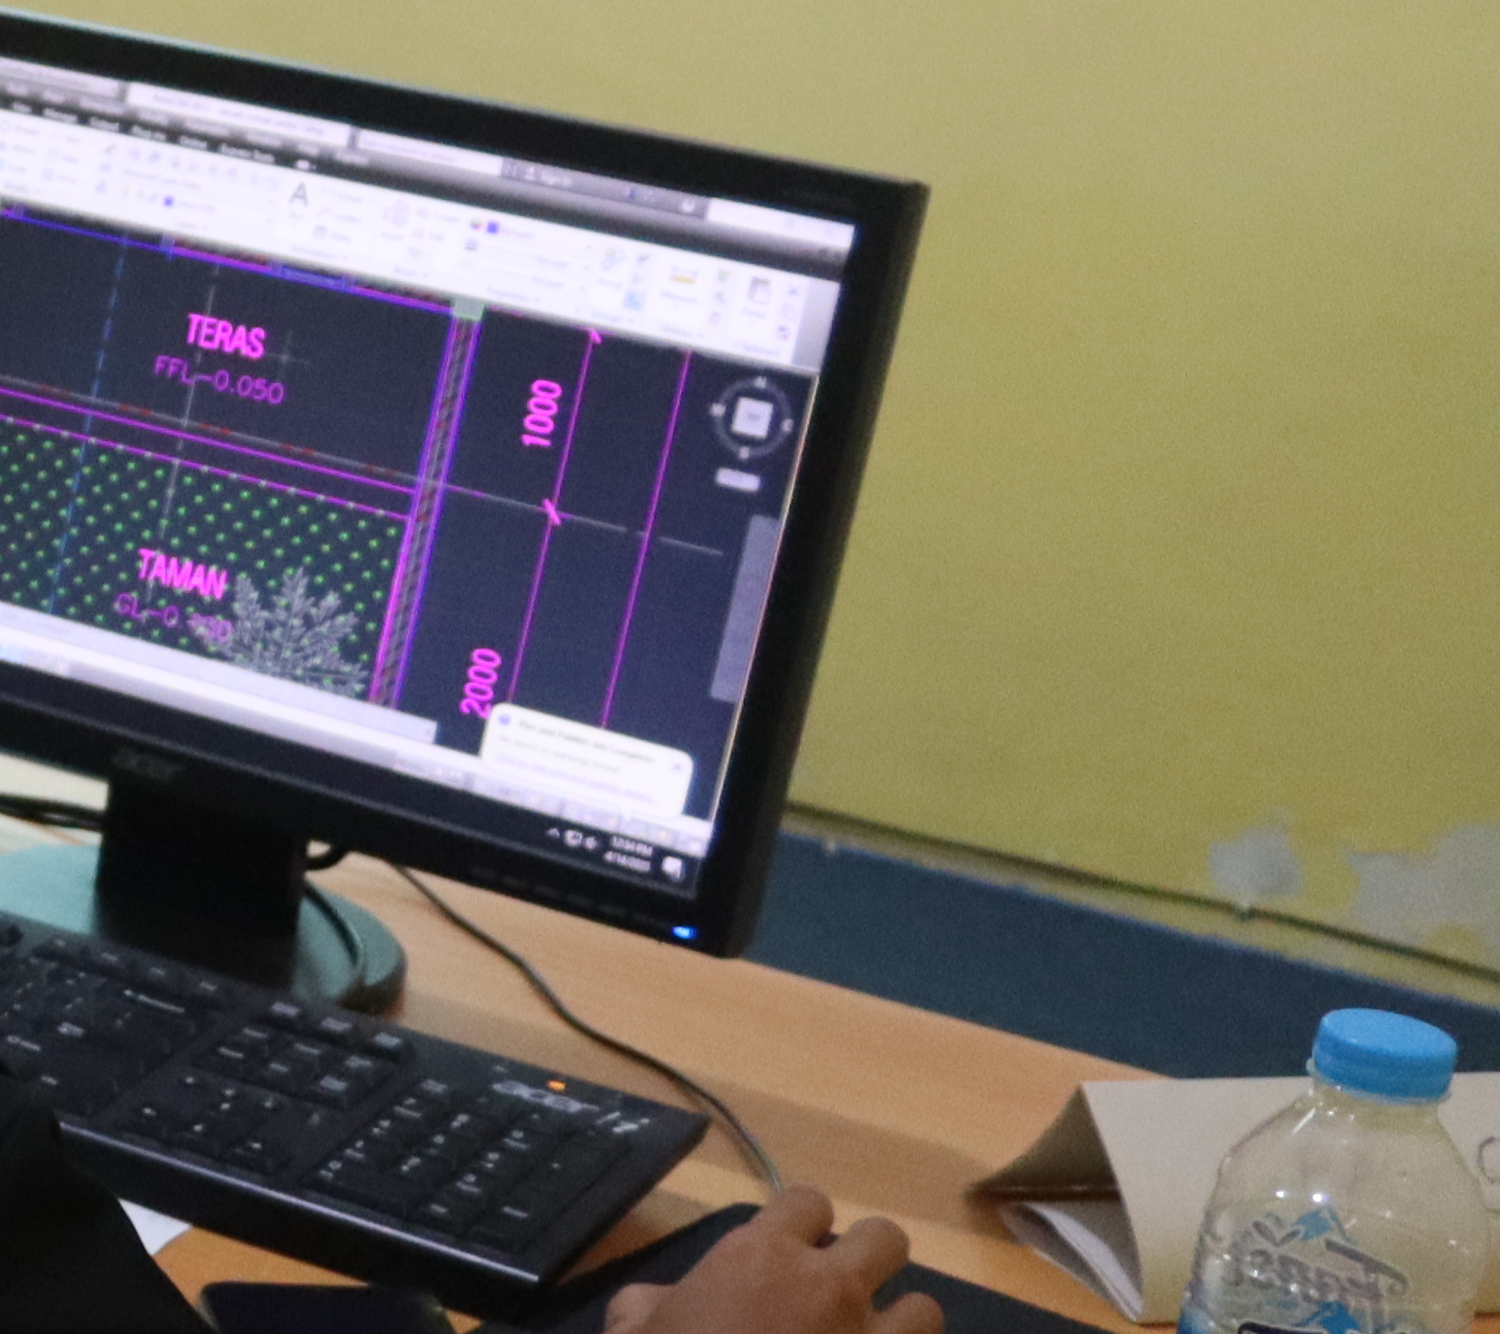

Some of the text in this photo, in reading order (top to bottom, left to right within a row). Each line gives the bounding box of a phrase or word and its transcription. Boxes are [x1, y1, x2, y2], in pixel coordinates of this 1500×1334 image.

[186, 312, 267, 359] TERAS
[153, 355, 286, 405] FFL-0.050
[520, 378, 564, 449] 1000
[138, 548, 229, 600] TAMAN
[459, 647, 503, 720] 2000
